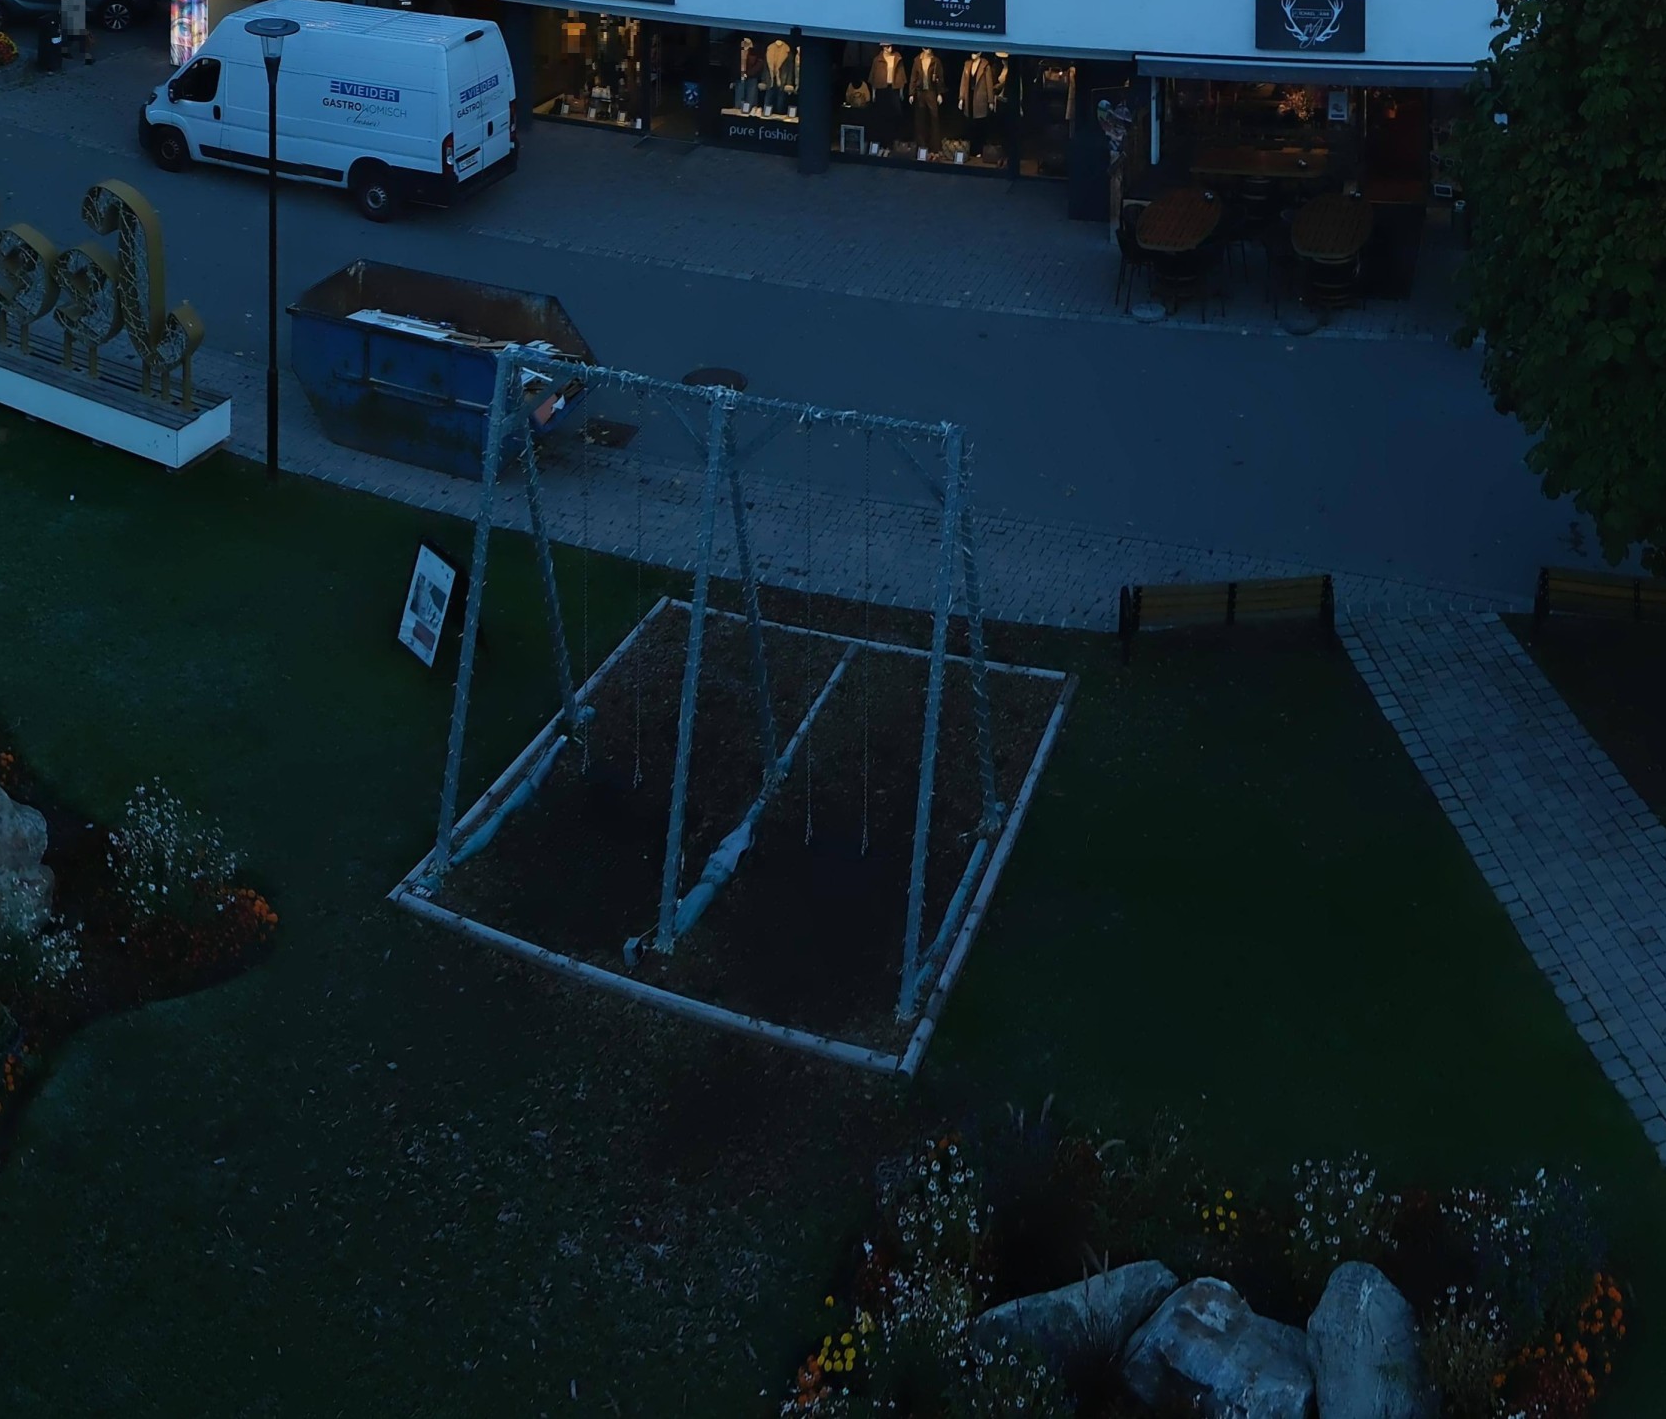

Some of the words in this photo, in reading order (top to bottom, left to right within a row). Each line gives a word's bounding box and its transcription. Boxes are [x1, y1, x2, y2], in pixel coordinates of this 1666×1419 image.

[914, 19, 943, 27] SEEFELD
[945, 21, 981, 29] SHOPPING
[344, 83, 396, 101] VIEIDER
[467, 76, 498, 99] VIEIDER
[322, 97, 407, 119] GASTRONOMISCH
[729, 125, 755, 137] pure
